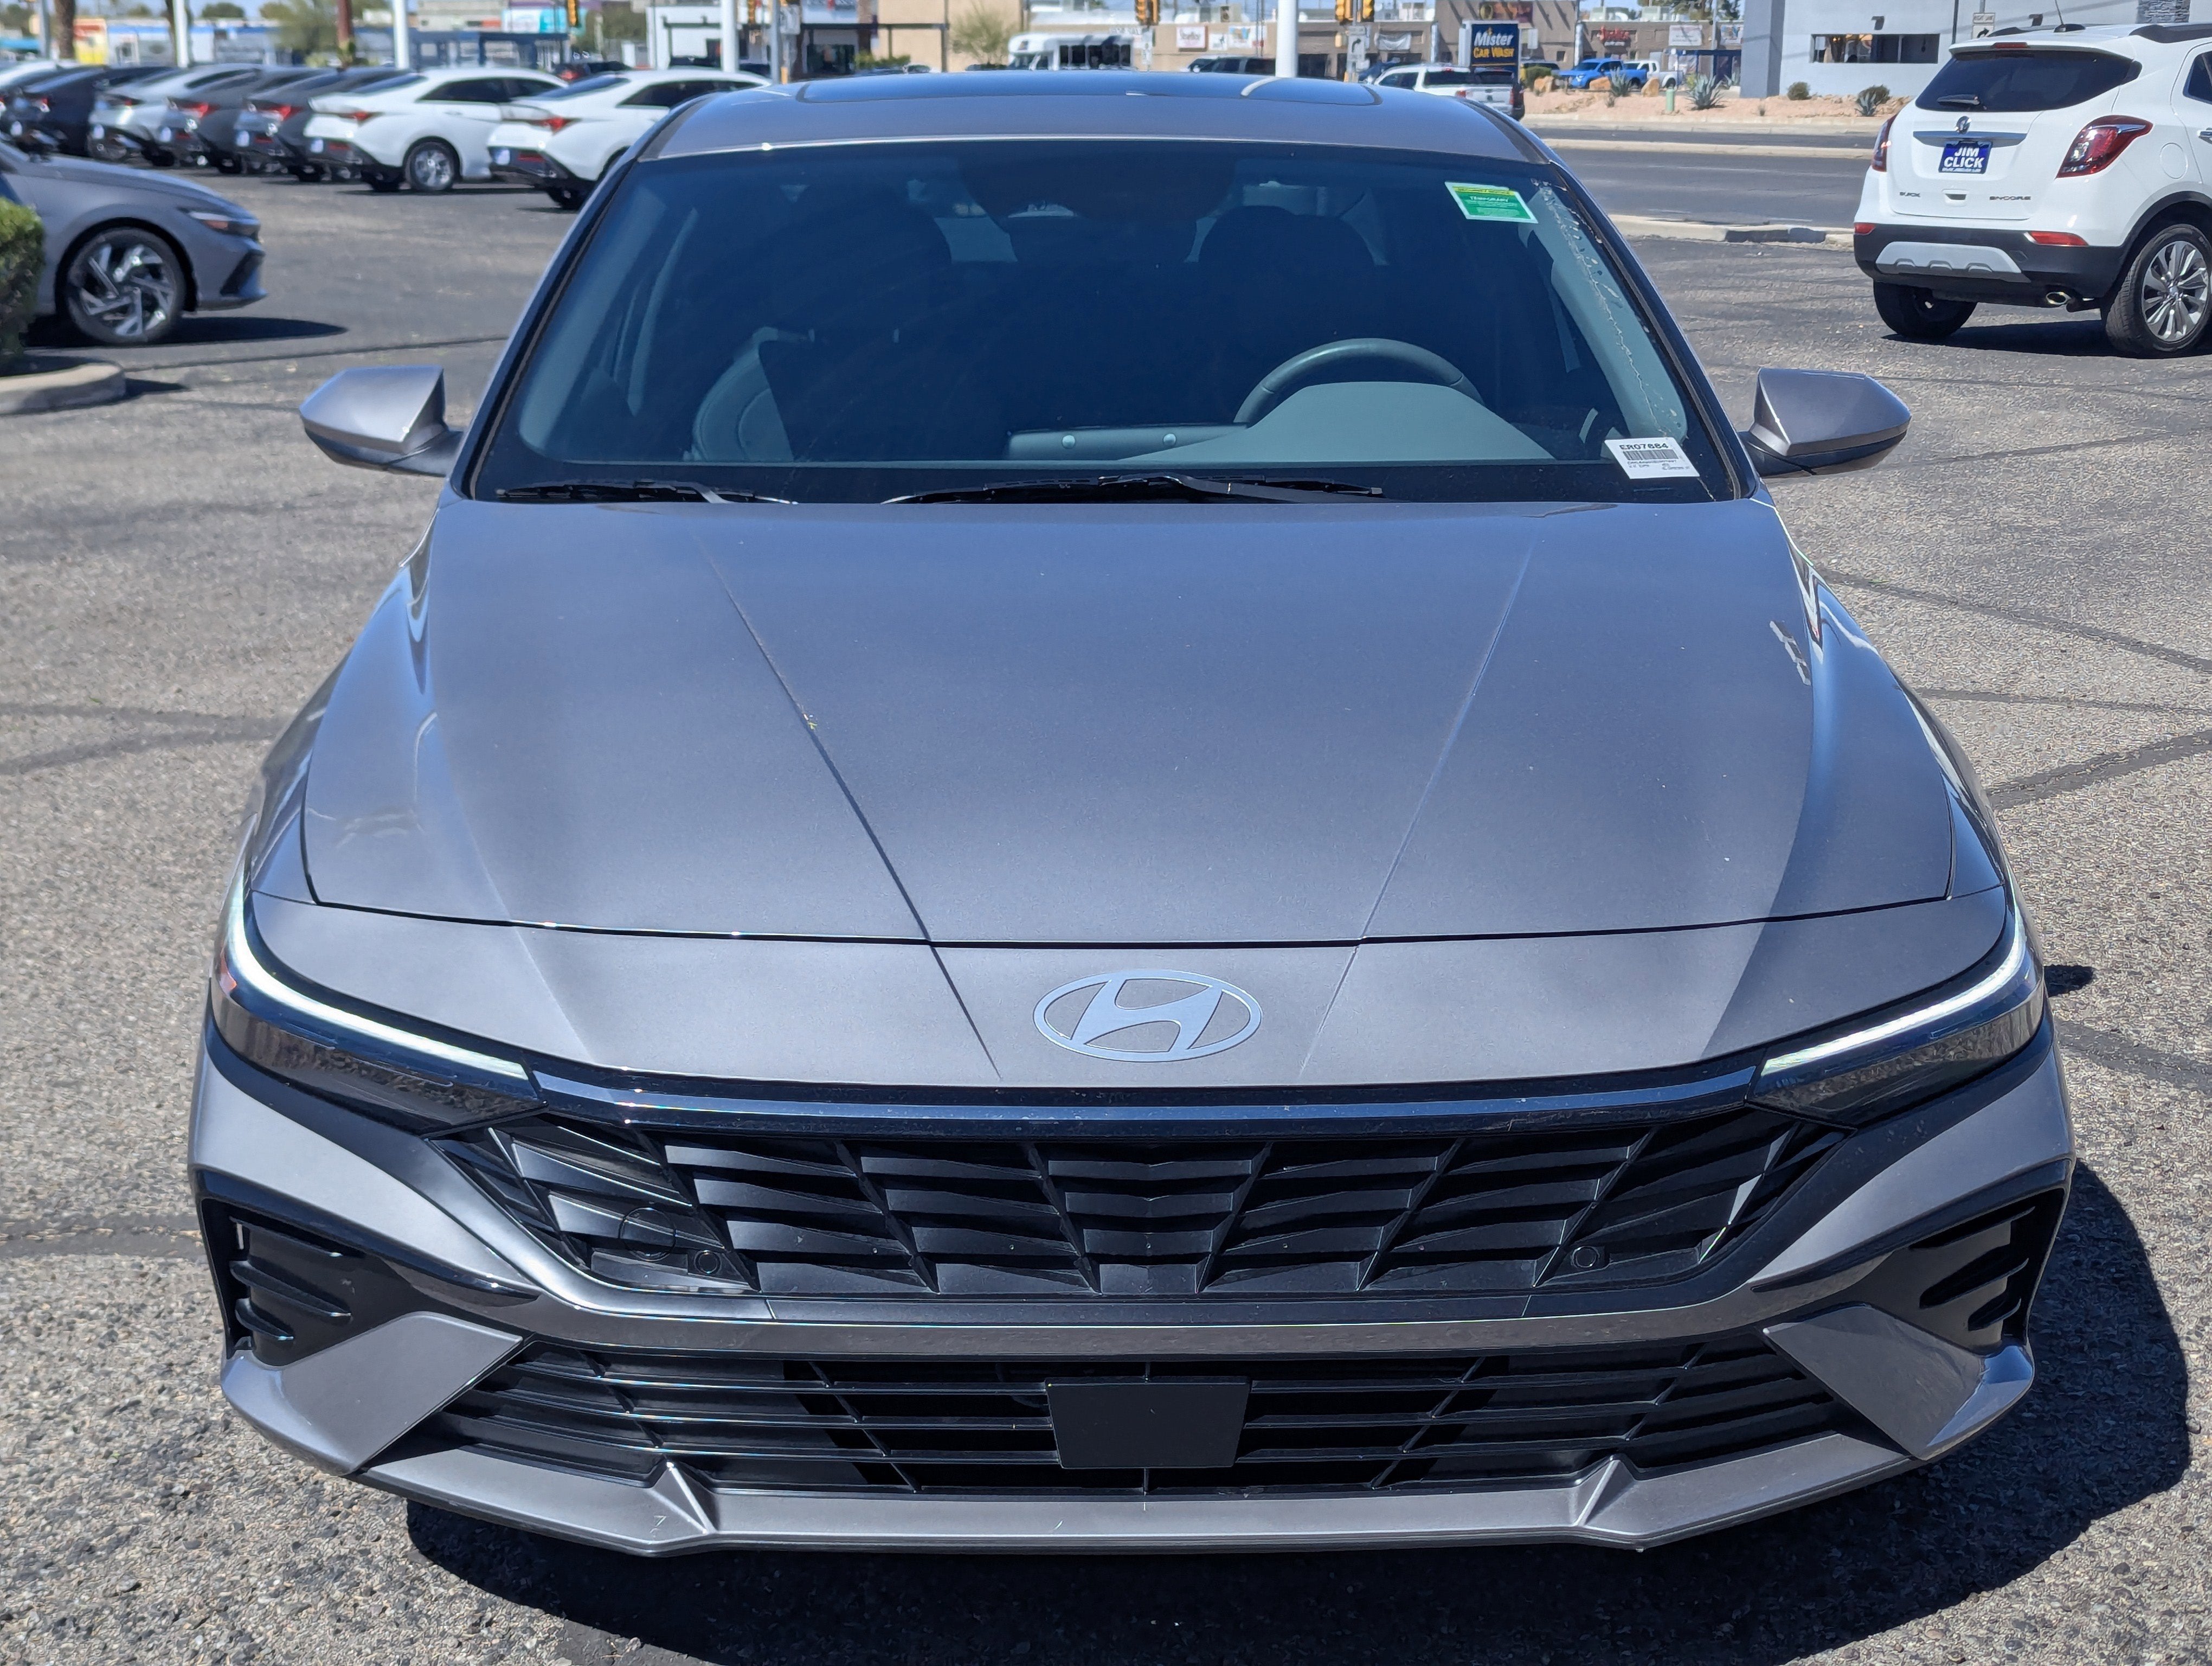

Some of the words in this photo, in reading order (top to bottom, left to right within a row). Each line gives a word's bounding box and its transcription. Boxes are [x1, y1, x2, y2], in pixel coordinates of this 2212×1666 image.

[1474, 30, 1514, 46] Mister
[1954, 146, 1980, 157] JIM
[1944, 156, 1985, 168] CLICK
